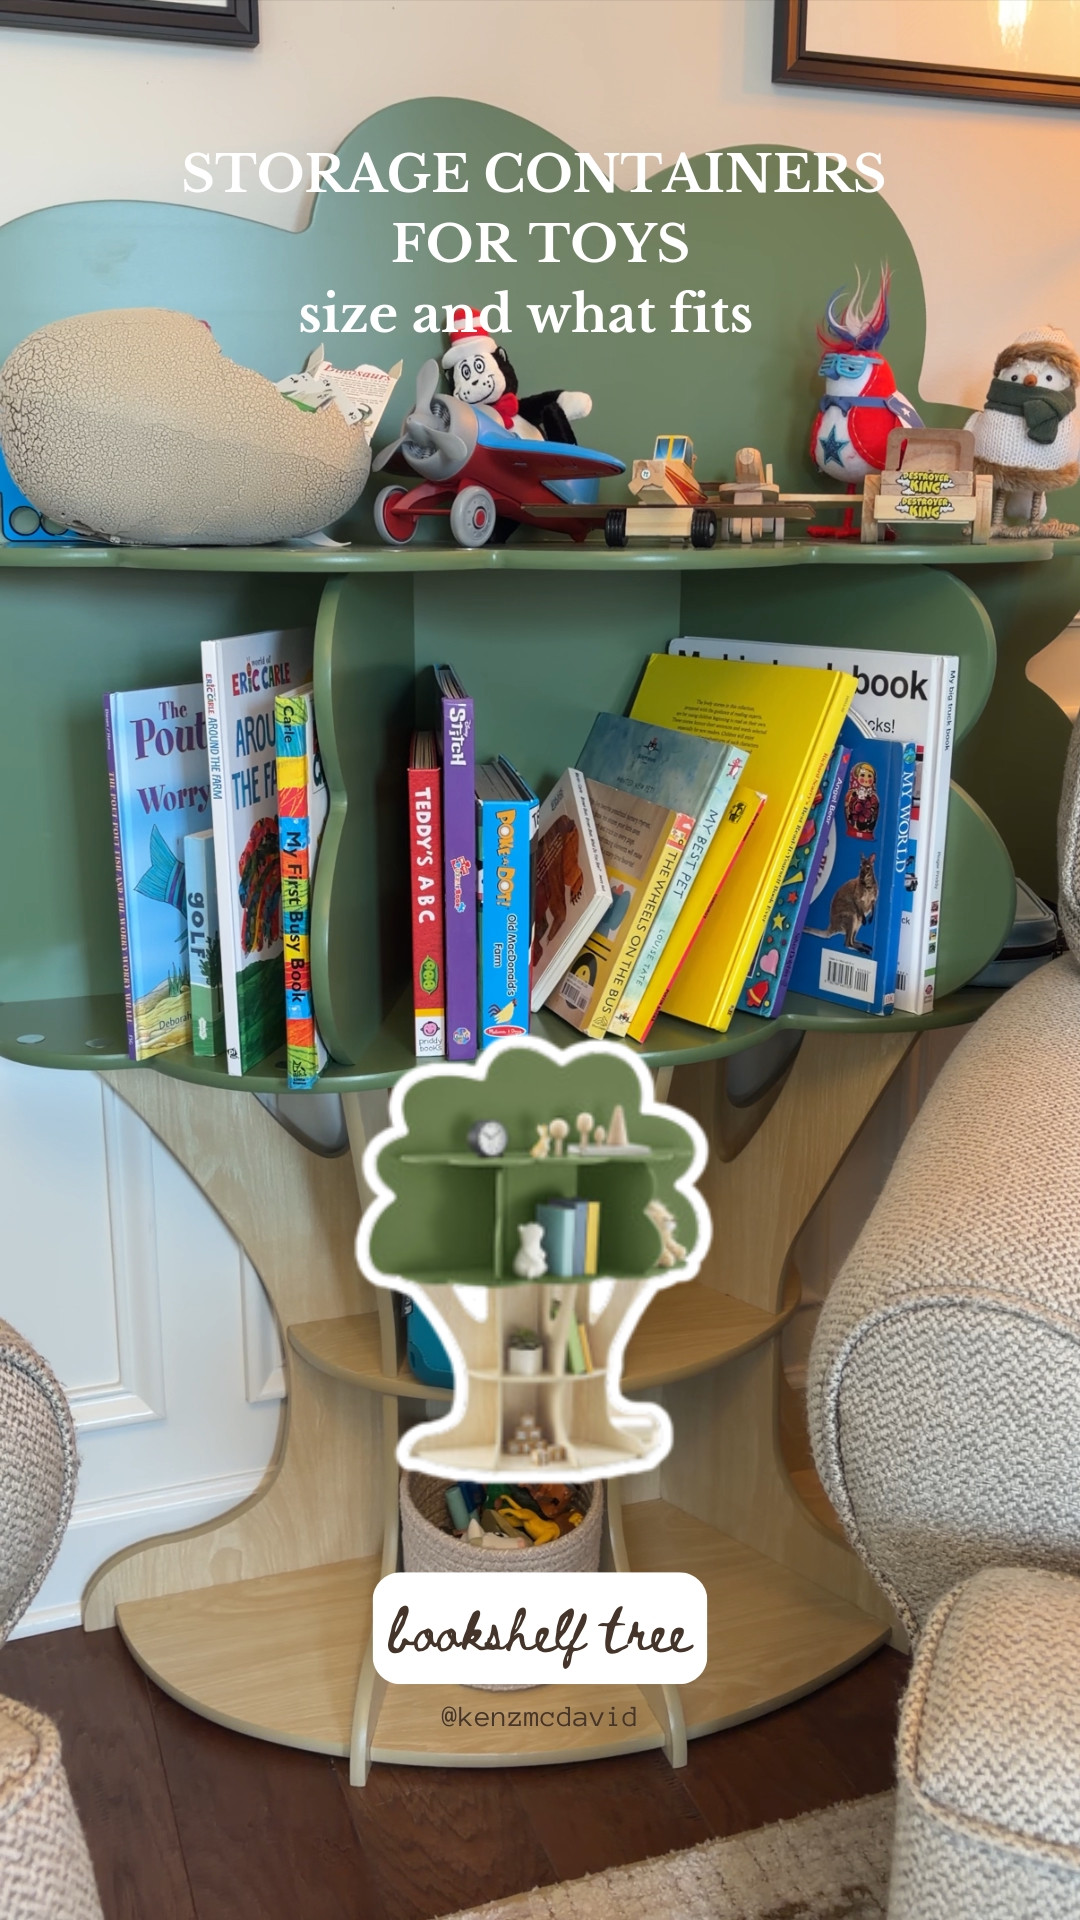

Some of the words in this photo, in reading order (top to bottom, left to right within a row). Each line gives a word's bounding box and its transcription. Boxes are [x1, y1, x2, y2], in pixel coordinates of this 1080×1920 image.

[902, 471, 950, 483] DESTROYER
[909, 480, 941, 494] KING
[902, 497, 950, 507] DESTROYER
[909, 505, 941, 519] KING
[261, 662, 291, 690] CARLE
[853, 665, 929, 701] book
[948, 669, 956, 686] My
[158, 700, 188, 721] The
[129, 712, 208, 761] Pout
[208, 717, 218, 755] AROUND
[236, 710, 276, 758] AROU
[283, 705, 296, 744] Carle
[866, 717, 897, 735] cks!
[944, 728, 952, 752] book
[210, 755, 221, 772] THE
[211, 774, 223, 800] FARM
[231, 765, 261, 810] THE
[830, 777, 843, 804] Angel
[901, 771, 914, 799] MY
[137, 783, 212, 815] Worry
[414, 787, 433, 866] TEDDY'S
[702, 809, 719, 835] MY
[825, 803, 837, 825] Bear
[283, 830, 302, 860] My
[895, 802, 911, 873] WORLD
[657, 851, 679, 880] THE
[684, 835, 708, 872] BEST
[287, 864, 303, 905] First
[672, 871, 692, 899] PET
[635, 878, 667, 933] WHEELS
[286, 910, 304, 953] Busy
[506, 913, 517, 931] Old
[493, 942, 504, 969] Farm
[625, 934, 642, 958] ON
[646, 929, 666, 961] LOUISE
[506, 933, 518, 996] MacDonald's
[612, 961, 633, 987] THE
[635, 963, 650, 987] TATE
[289, 958, 306, 1003] Book
[601, 988, 619, 1014] BUS
[158, 1013, 192, 1030] Deborah
[418, 1037, 443, 1046] priddy
